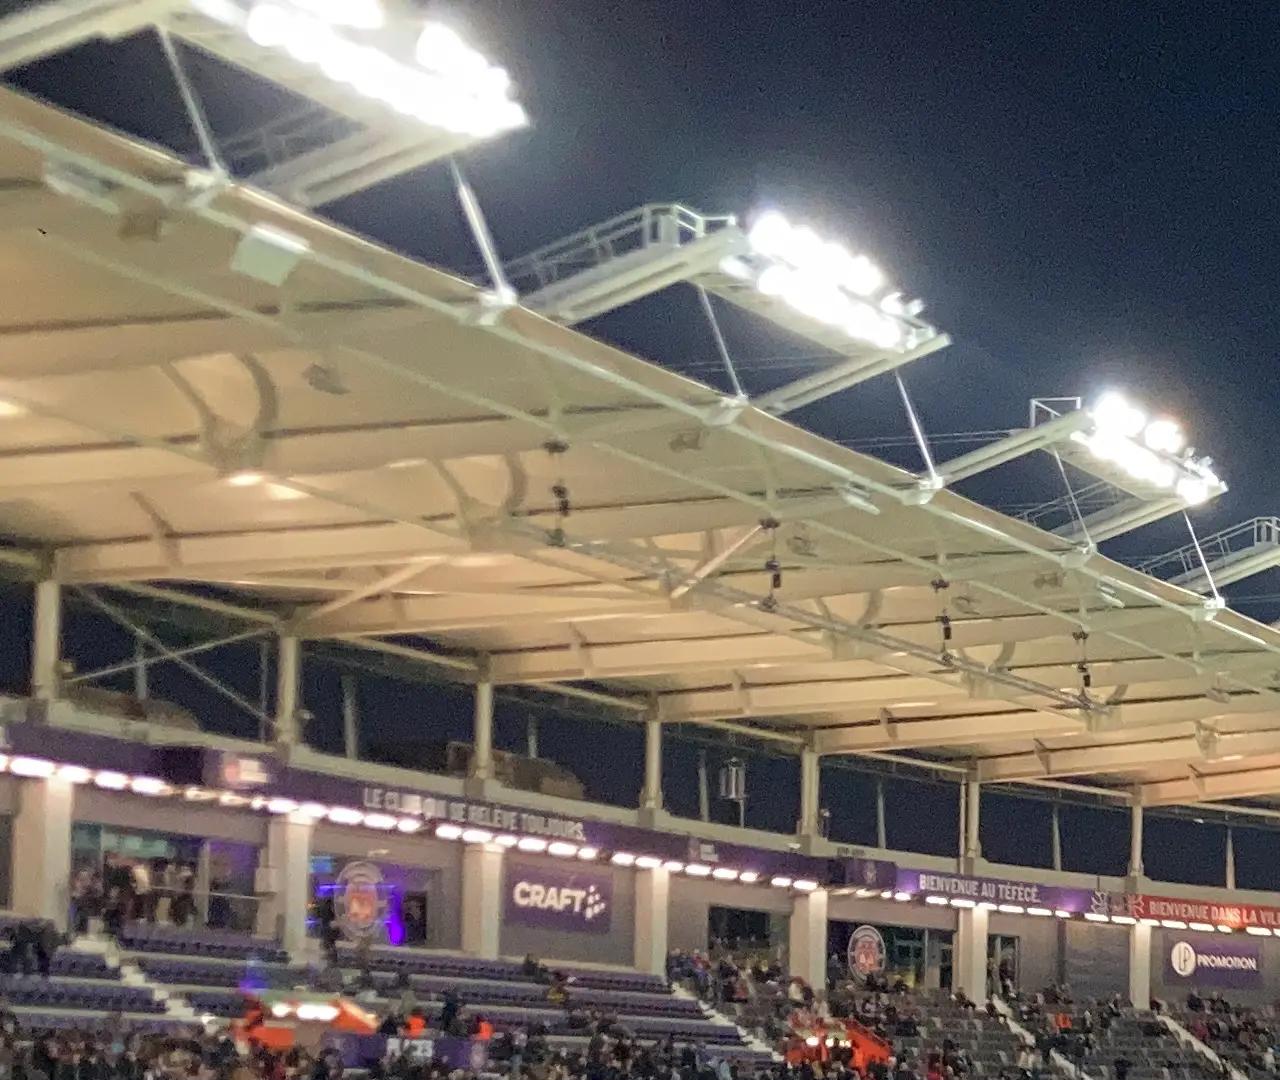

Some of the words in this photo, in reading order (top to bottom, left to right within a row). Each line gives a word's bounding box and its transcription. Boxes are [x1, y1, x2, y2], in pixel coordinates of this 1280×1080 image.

[513, 881, 586, 913] CRAFT
[919, 873, 979, 897] BIENVENUE
[981, 883, 996, 898] AU
[1149, 900, 1209, 921] BIENVENUE
[1211, 906, 1241, 924] DANS
[1242, 909, 1258, 924] LA
[1197, 953, 1257, 971] PROMOTION
